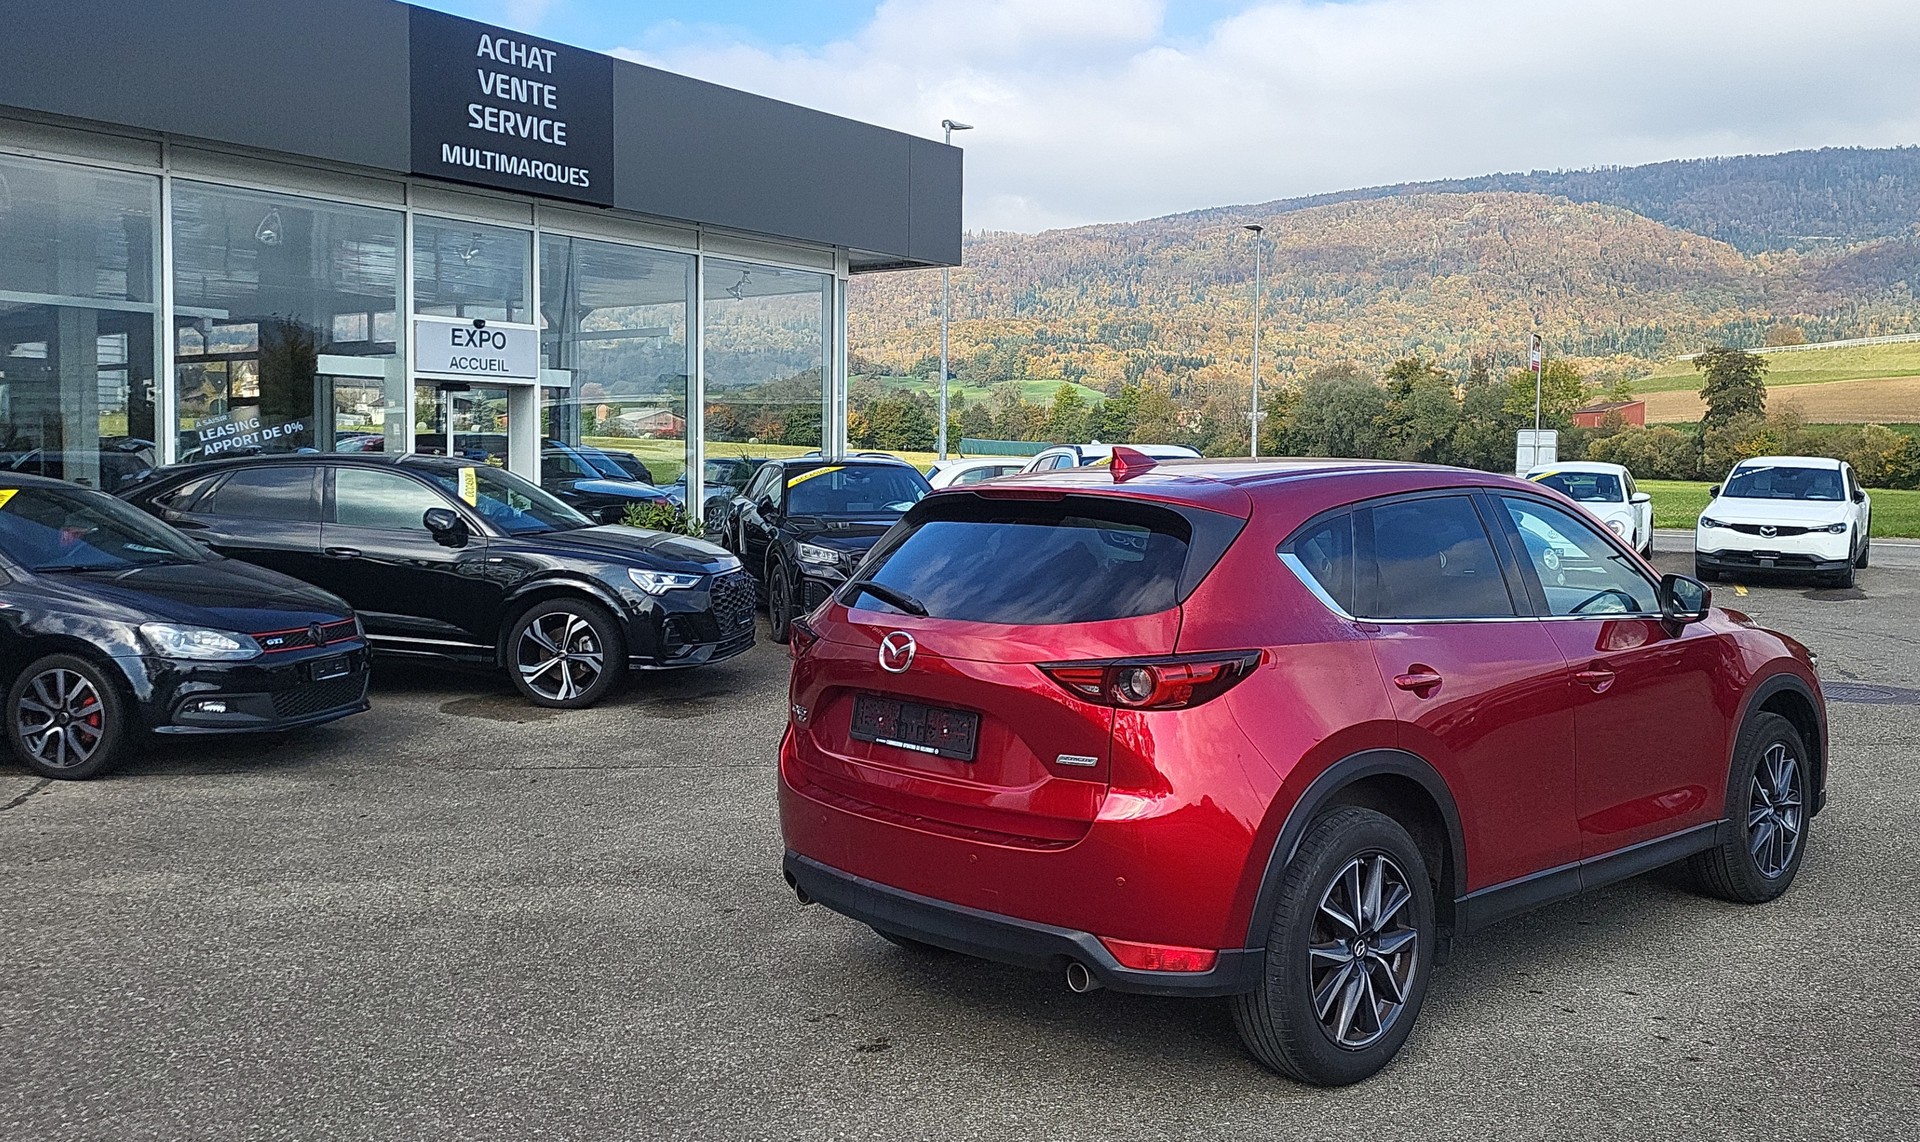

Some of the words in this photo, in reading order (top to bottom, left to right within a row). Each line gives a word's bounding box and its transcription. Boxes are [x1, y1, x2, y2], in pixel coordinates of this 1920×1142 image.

[476, 33, 557, 74] ACHAT
[477, 69, 557, 110] VENTE
[467, 103, 567, 147] SERVICE
[442, 143, 590, 188] MULTIMARQUES
[451, 328, 507, 350] EXPO
[449, 356, 509, 372] ACCUEIL
[198, 417, 260, 442] LEASING
[203, 431, 260, 456] APPORT
[262, 426, 282, 441] DE
[284, 421, 304, 435] 0%
[266, 637, 284, 646] GTI
